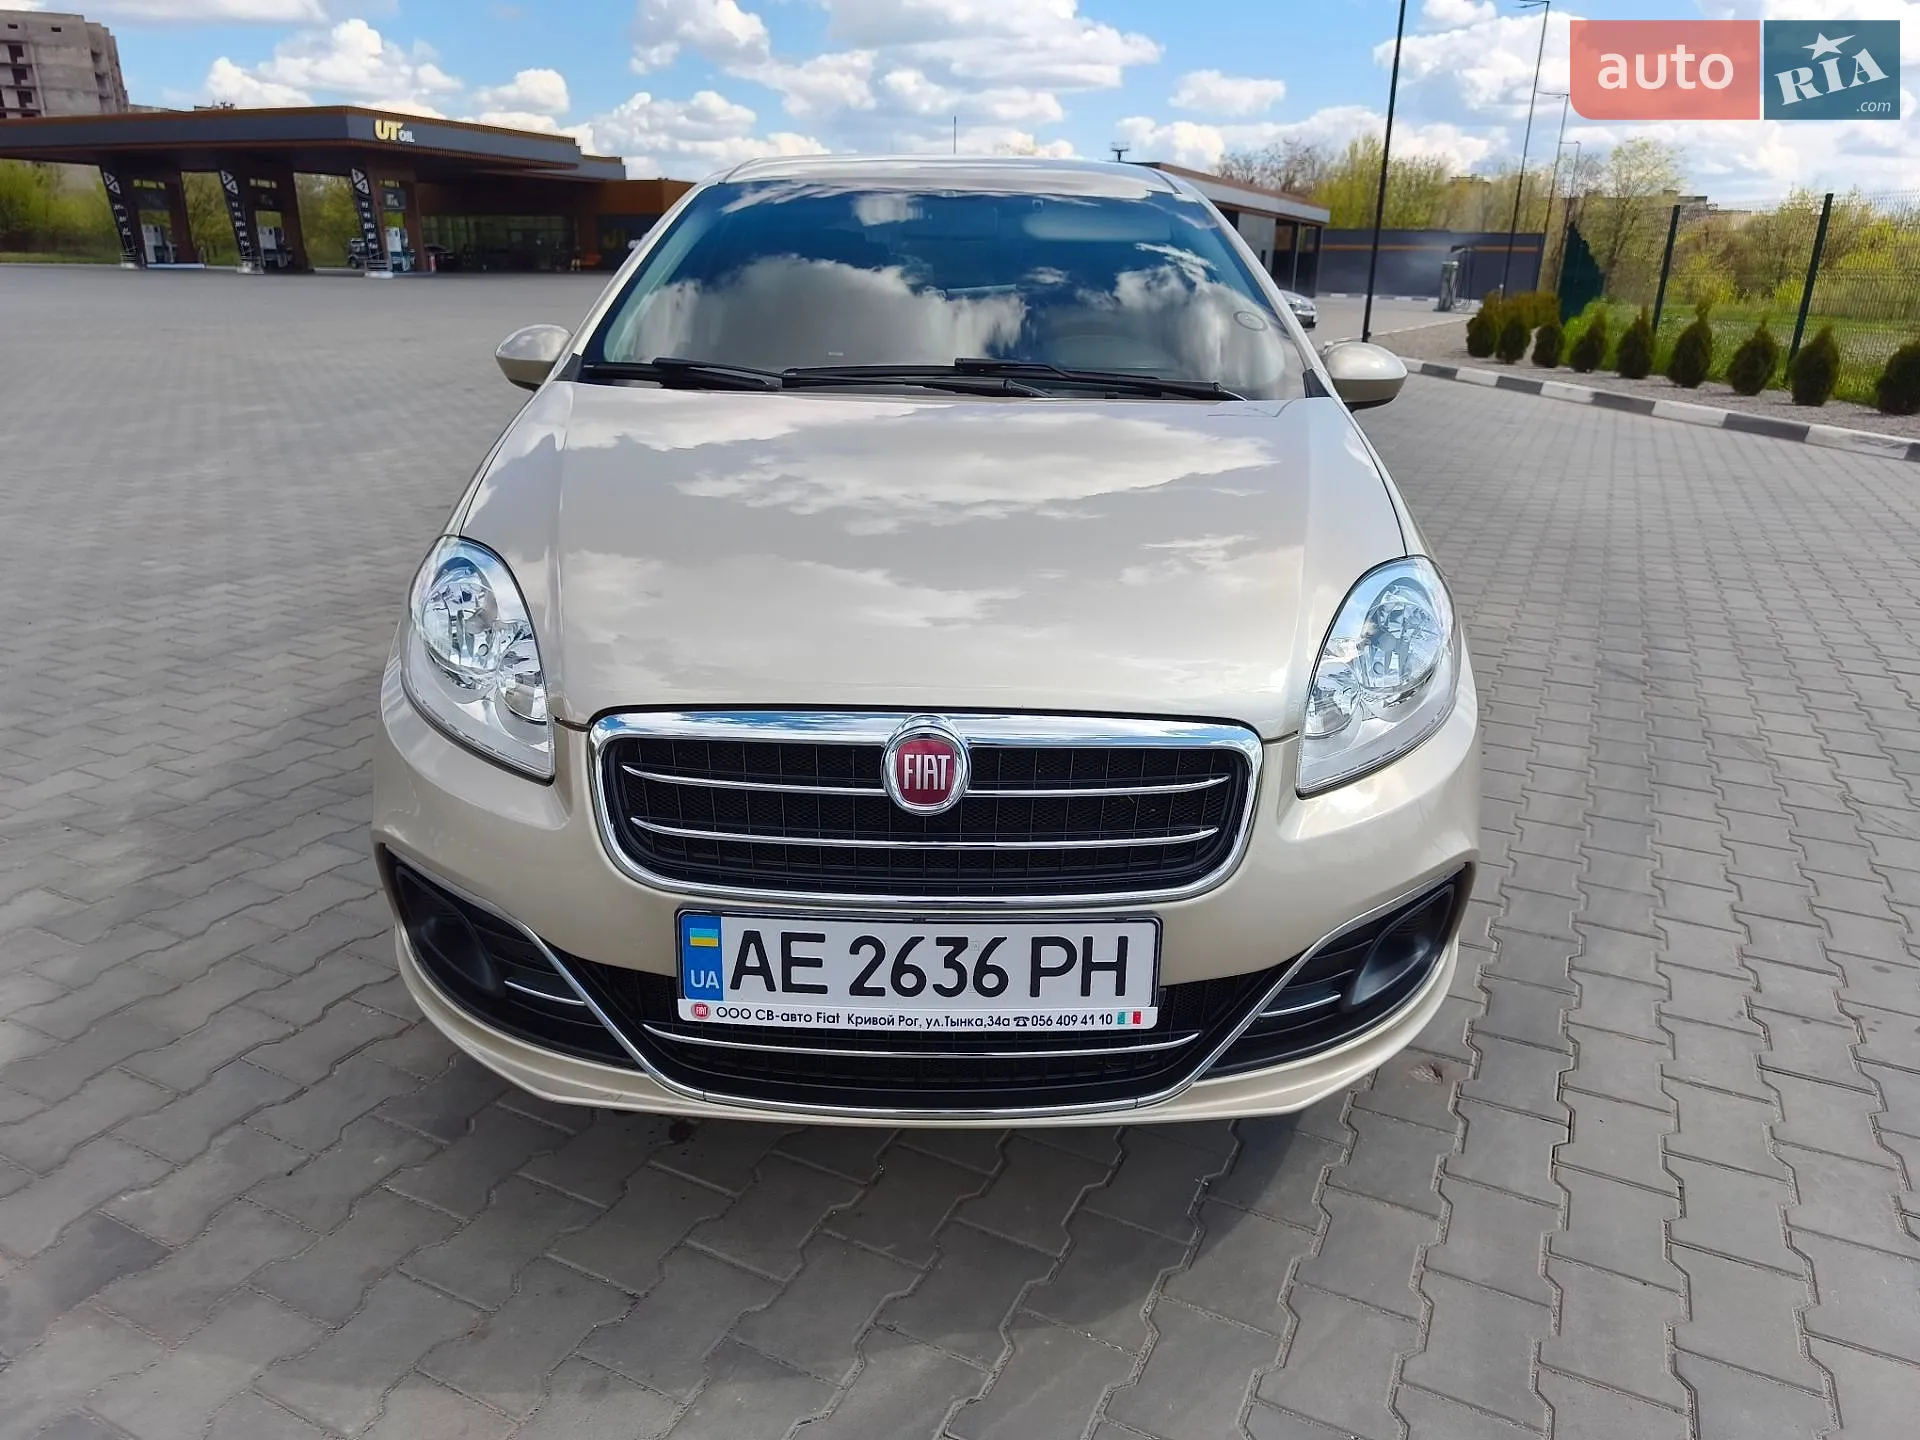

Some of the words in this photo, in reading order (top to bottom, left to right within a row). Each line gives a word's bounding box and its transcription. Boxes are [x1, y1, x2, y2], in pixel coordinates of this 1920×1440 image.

[903, 753, 951, 791] FIAT
[729, 930, 829, 995] AE
[849, 935, 1009, 998] 2636
[1029, 935, 1129, 998] PH
[690, 969, 720, 989] UA
[695, 1005, 708, 1017] FIAT
[716, 1006, 752, 1020] ООО
[755, 1009, 812, 1024] СВ-авто
[816, 1011, 840, 1025] Fiat
[847, 1013, 896, 1029] Кривой
[898, 1015, 923, 1029] Рог,
[1031, 1014, 1053, 1028] 056
[1055, 1013, 1078, 1027] 409
[1080, 1013, 1096, 1026] 41
[1098, 1012, 1114, 1025] 10
